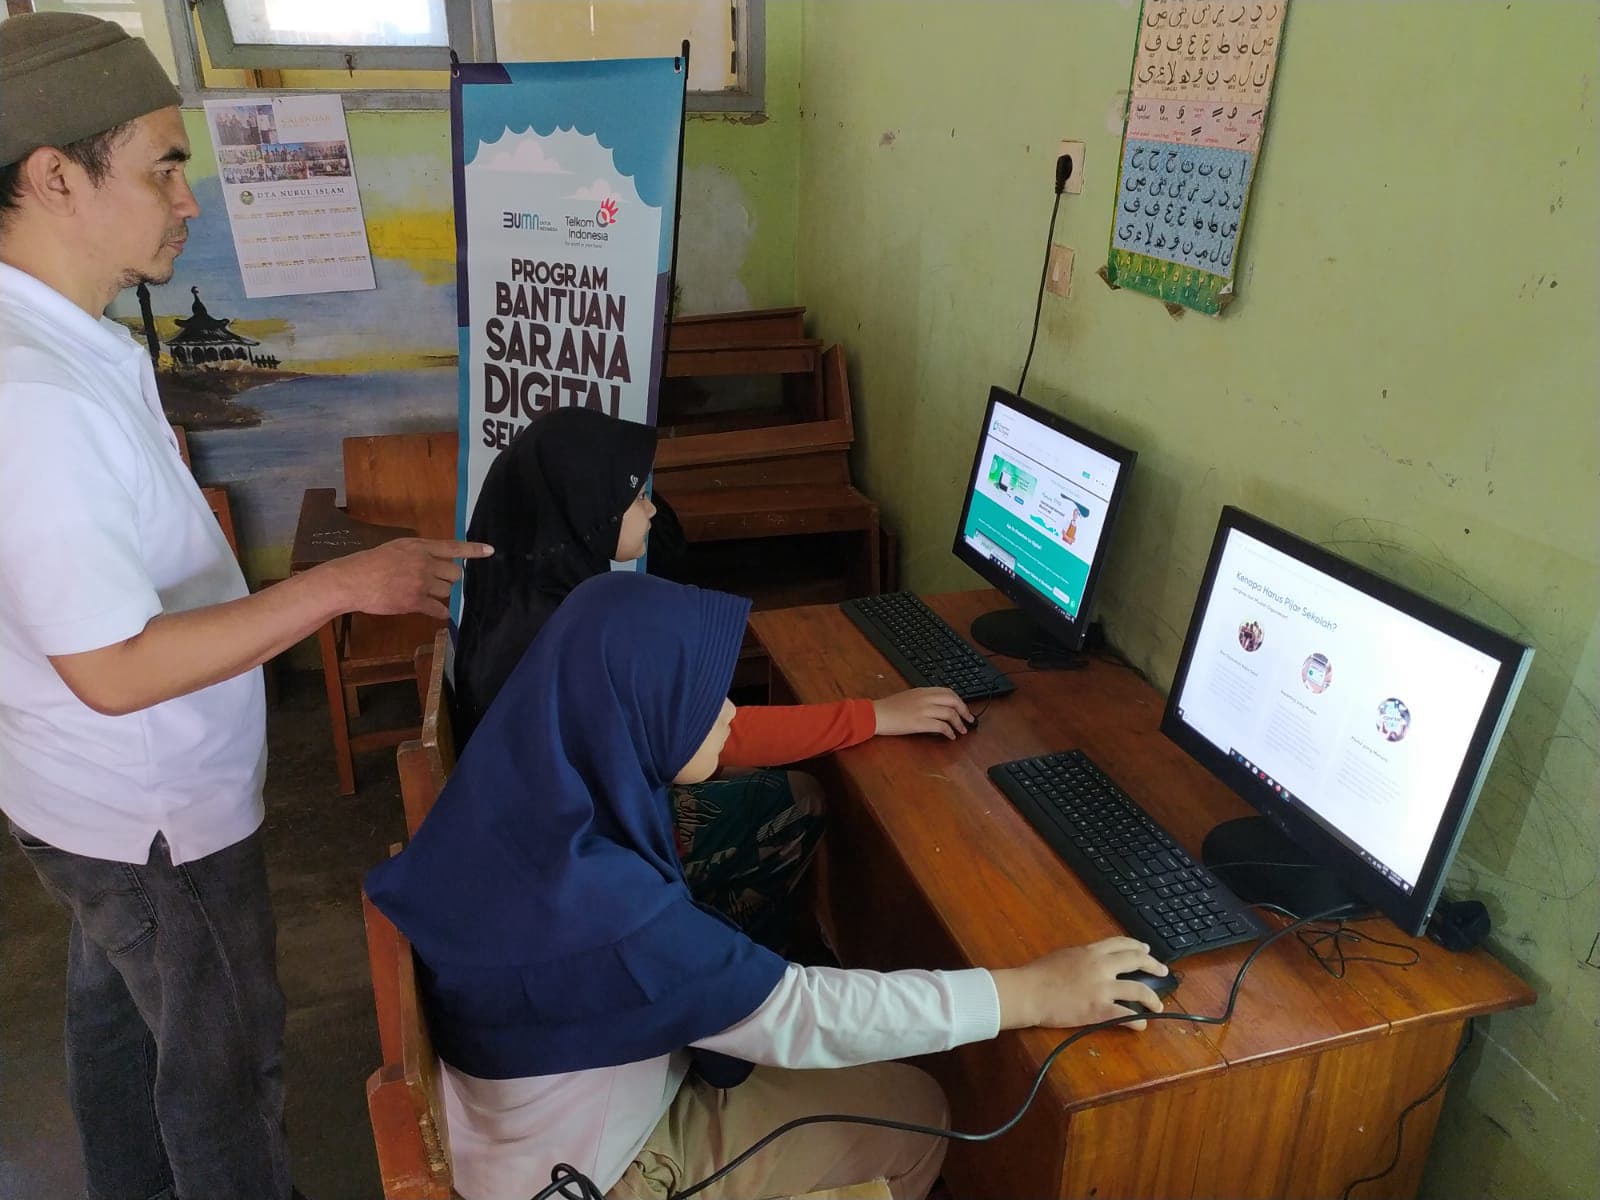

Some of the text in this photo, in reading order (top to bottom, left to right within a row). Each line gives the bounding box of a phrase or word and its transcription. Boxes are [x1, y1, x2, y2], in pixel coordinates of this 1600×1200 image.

[315, 187, 344, 195] ISLAM
[565, 216, 595, 228] Telkom
[568, 228, 609, 241] Indonesia
[511, 258, 608, 291] PROGRAM
[495, 281, 626, 332] BANTUAN
[485, 317, 632, 384] SARANA
[1236, 570, 1263, 591] Kenapa
[1263, 585, 1283, 603] Harus
[1284, 597, 1301, 611] Pijar
[1302, 606, 1338, 632] Sekolah?
